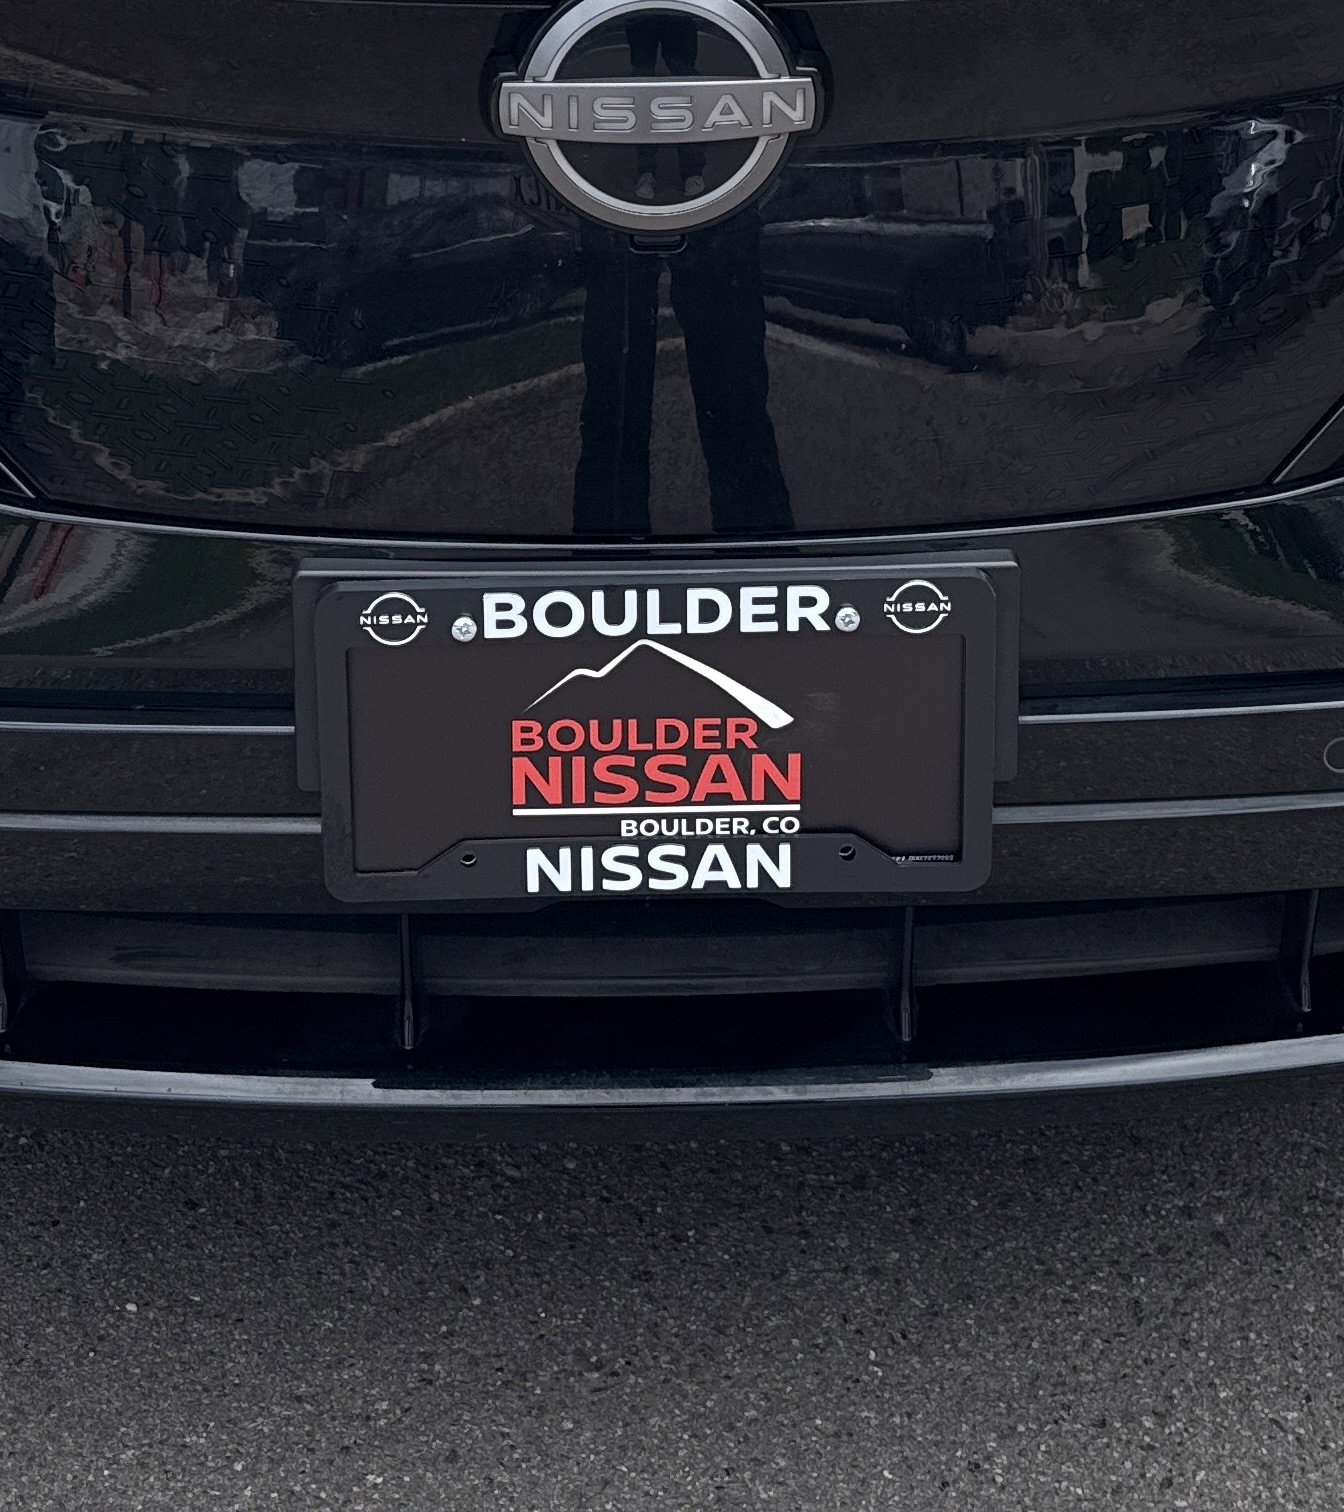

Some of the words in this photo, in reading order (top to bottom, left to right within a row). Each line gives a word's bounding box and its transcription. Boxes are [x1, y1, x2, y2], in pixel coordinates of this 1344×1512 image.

[508, 88, 806, 133] NISSAN
[359, 613, 429, 626] NISSAN
[482, 585, 830, 639] BOULDER
[883, 601, 952, 613] NISSAN
[511, 717, 758, 752] BOULDER
[512, 753, 802, 805] NISSAN
[620, 817, 757, 838] BOULDER,
[762, 816, 800, 835] CO
[525, 844, 792, 893] NISSAN
